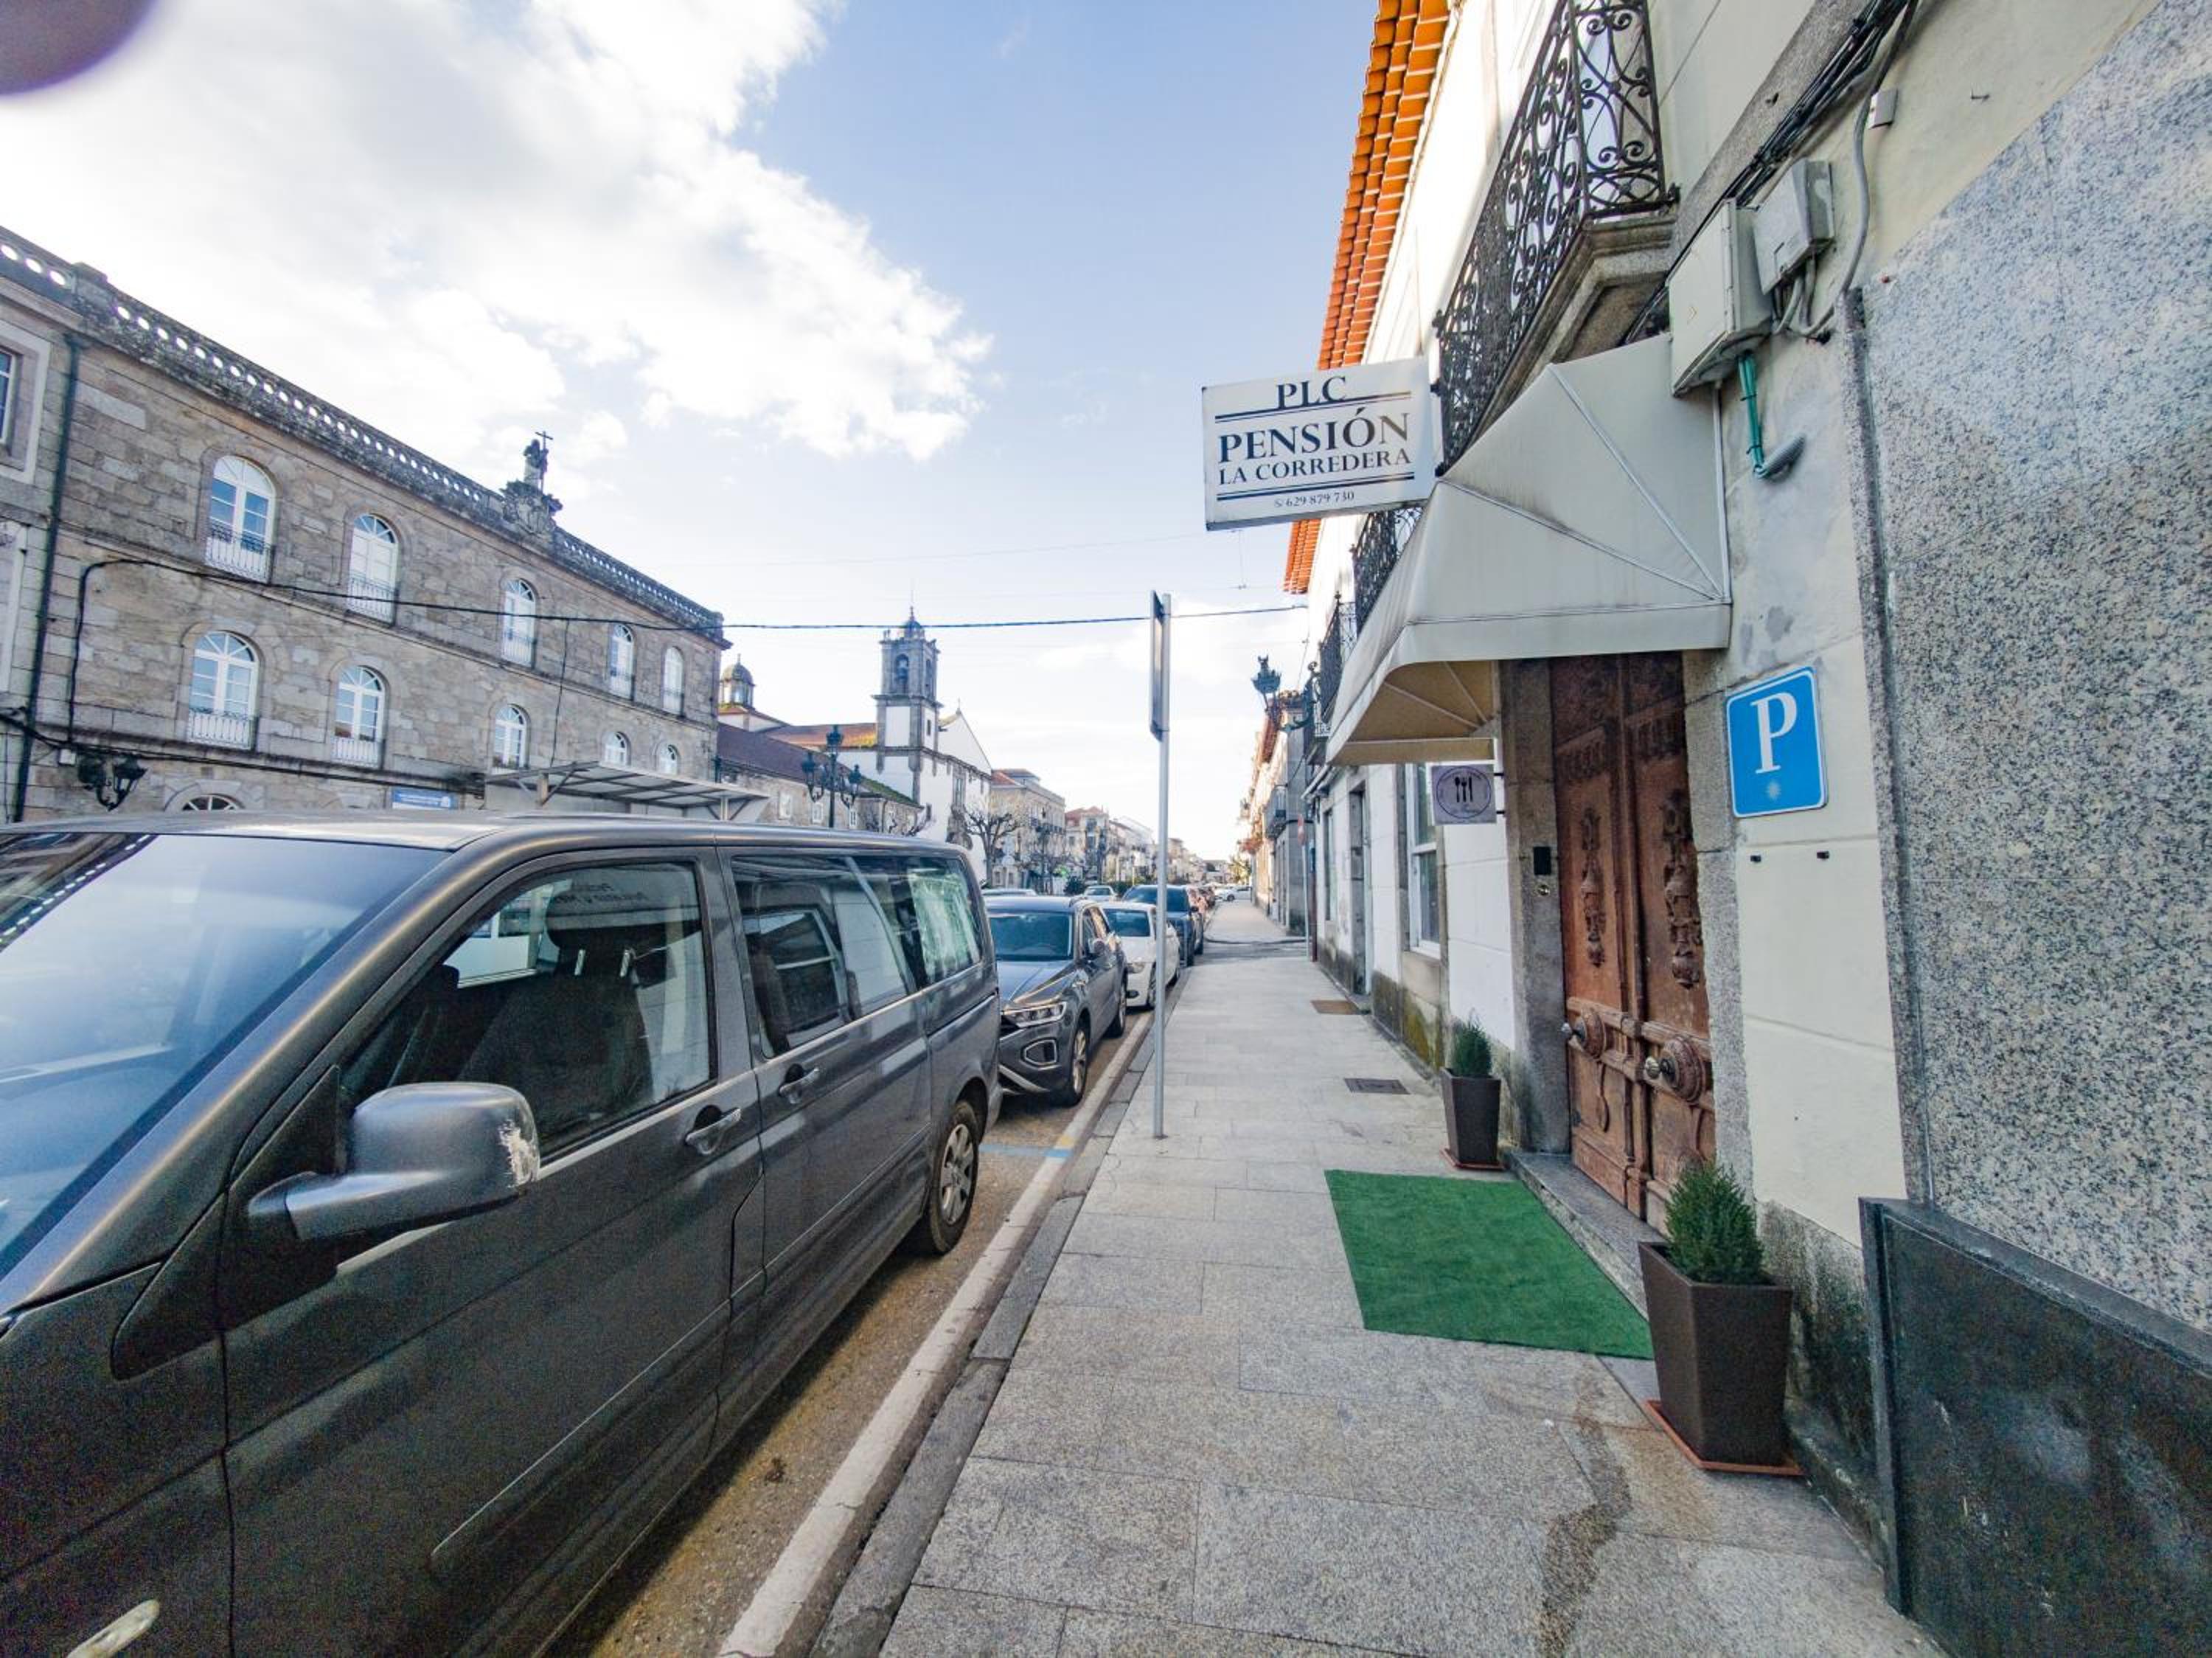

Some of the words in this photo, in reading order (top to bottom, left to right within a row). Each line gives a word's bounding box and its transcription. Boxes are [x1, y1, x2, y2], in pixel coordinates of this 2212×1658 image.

[1277, 376, 1346, 409] PLC
[1219, 408, 1410, 462] PENSIÓN
[1219, 466, 1247, 485] LA
[1256, 448, 1411, 480] CORREDERA
[1286, 496, 1307, 507] 629
[1310, 493, 1330, 504] 879
[1334, 490, 1354, 502] 730
[1750, 692, 1797, 774] P
